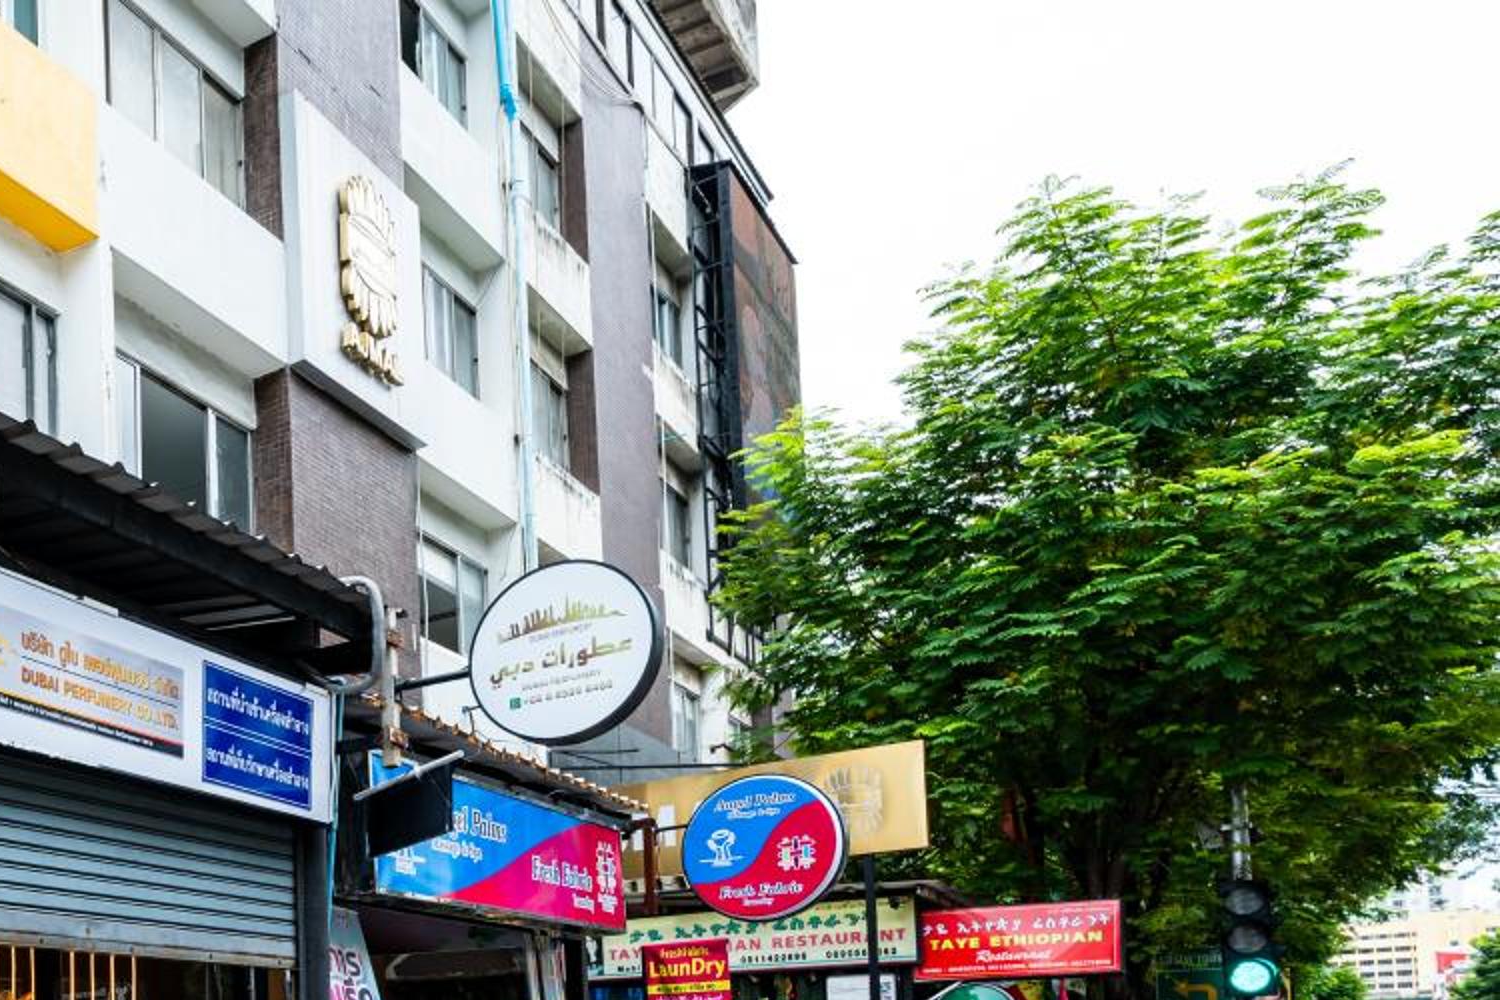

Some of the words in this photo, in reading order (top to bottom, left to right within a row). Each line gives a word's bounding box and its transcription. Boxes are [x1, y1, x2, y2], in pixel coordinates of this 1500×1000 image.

[542, 636, 633, 668] عطورات
[21, 666, 59, 693] DUBAI
[490, 660, 534, 689] دبي
[610, 948, 642, 961] TAY
[771, 928, 907, 950] RESTAURNT
[930, 937, 981, 951] TAYE
[990, 930, 1103, 949] ETHIOPIAN
[649, 957, 726, 979] LaunDry
